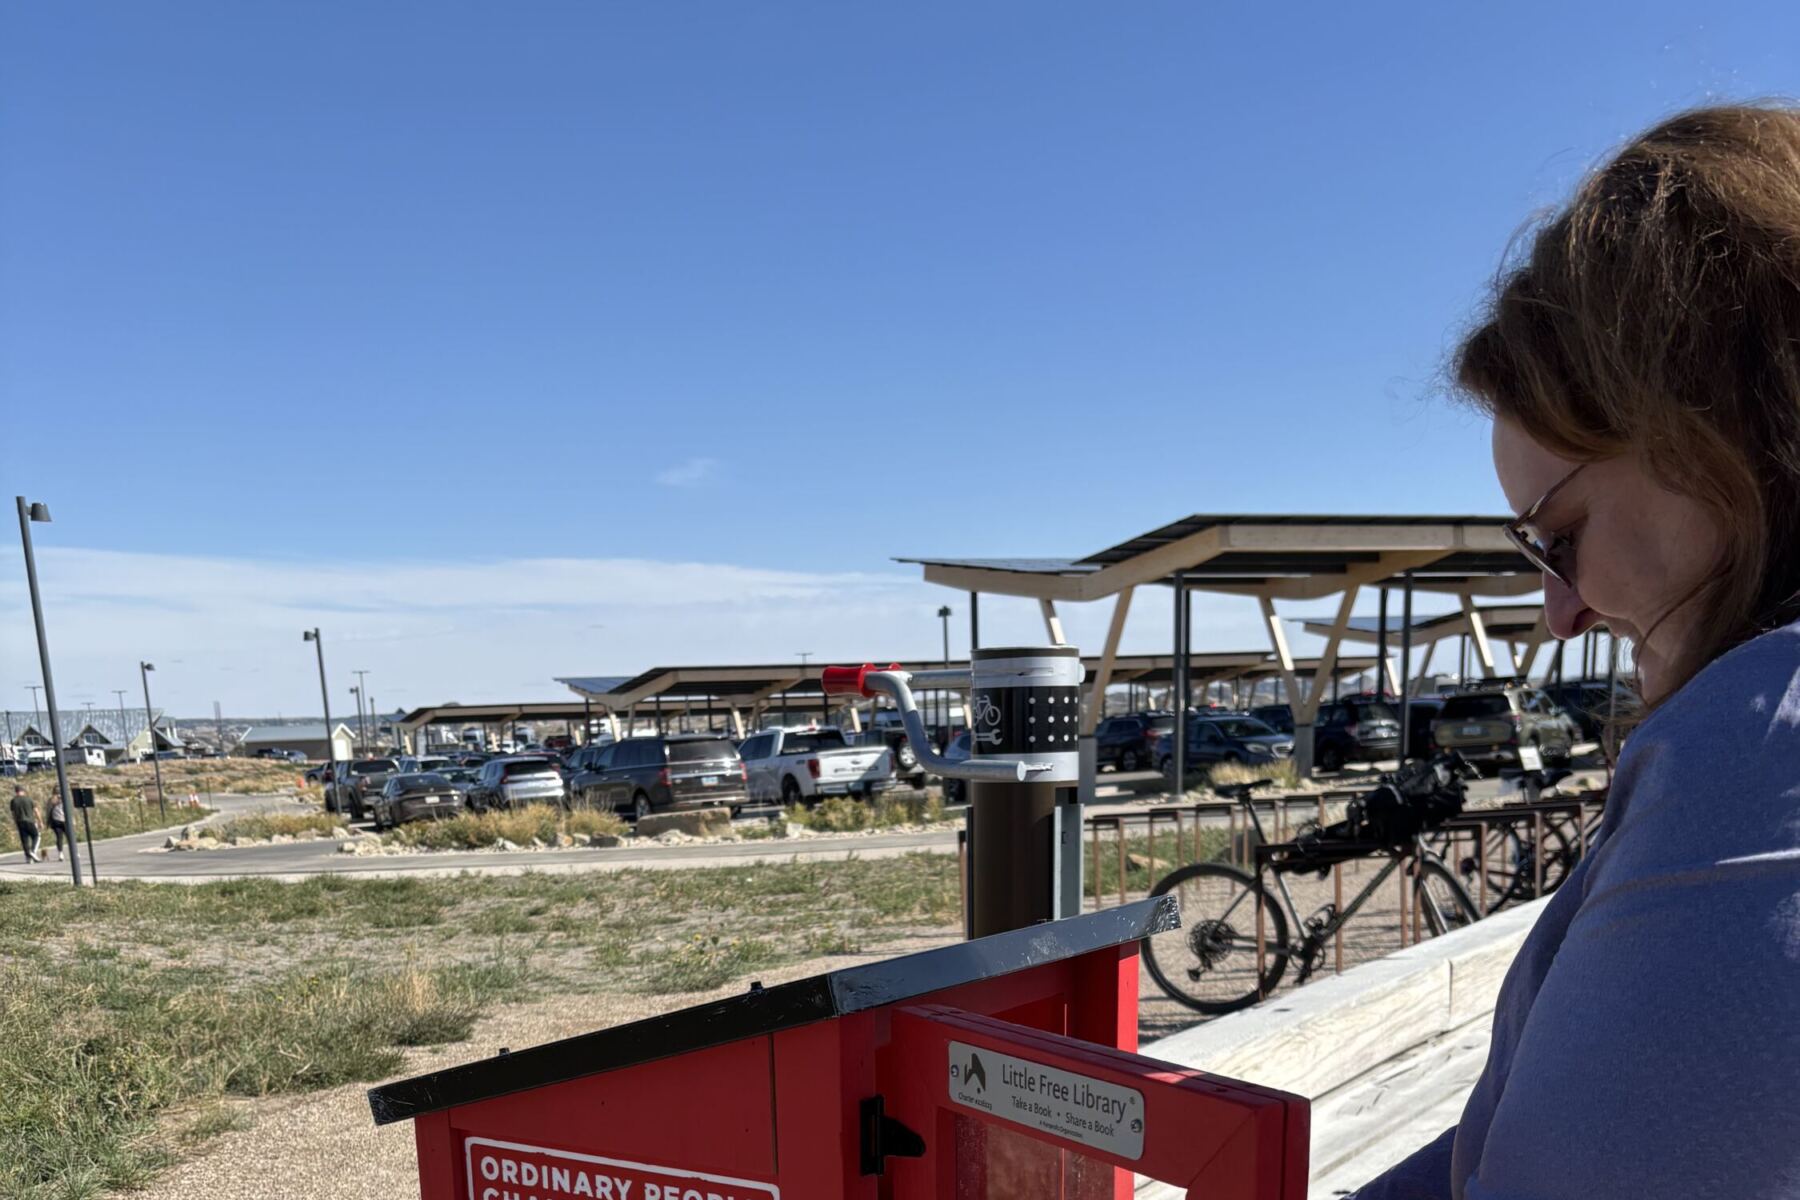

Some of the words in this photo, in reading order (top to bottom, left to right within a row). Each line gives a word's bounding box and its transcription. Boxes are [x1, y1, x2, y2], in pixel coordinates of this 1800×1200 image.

[1002, 1063, 1036, 1092] Little
[1039, 1074, 1069, 1102] Free
[1073, 1083, 1127, 1123] Library
[1011, 1095, 1028, 1111] Take
[1028, 1103, 1033, 1112] a
[1034, 1102, 1052, 1118] Book
[1065, 1111, 1087, 1129] Share
[1087, 1121, 1093, 1131] a
[1094, 1119, 1115, 1137] Book
